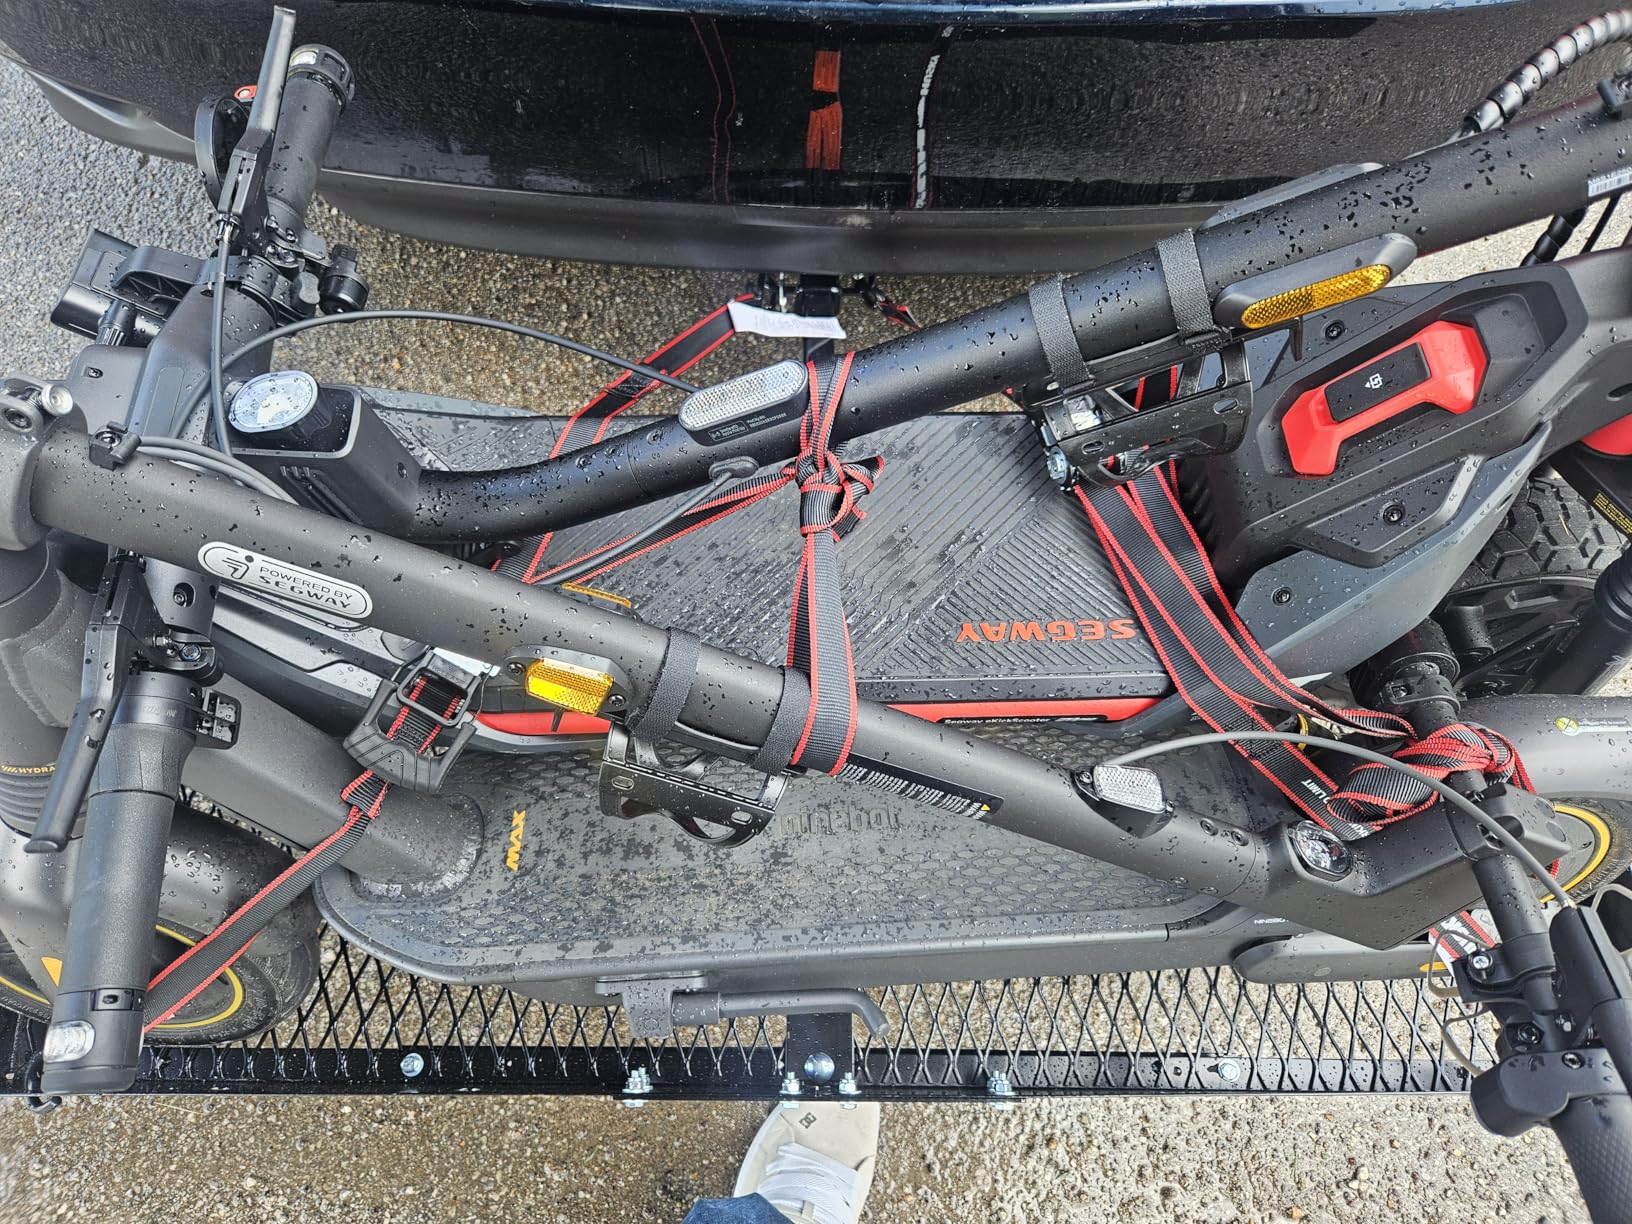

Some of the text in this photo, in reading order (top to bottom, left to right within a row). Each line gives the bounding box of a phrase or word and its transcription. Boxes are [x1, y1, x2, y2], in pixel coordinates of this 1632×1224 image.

[258, 575, 351, 609] SEGWAY
[259, 566, 353, 601] POWERED BY
[956, 618, 1138, 643] SEGWAY
[1301, 779, 1328, 799] LIMIT
[506, 809, 526, 872] MAX
